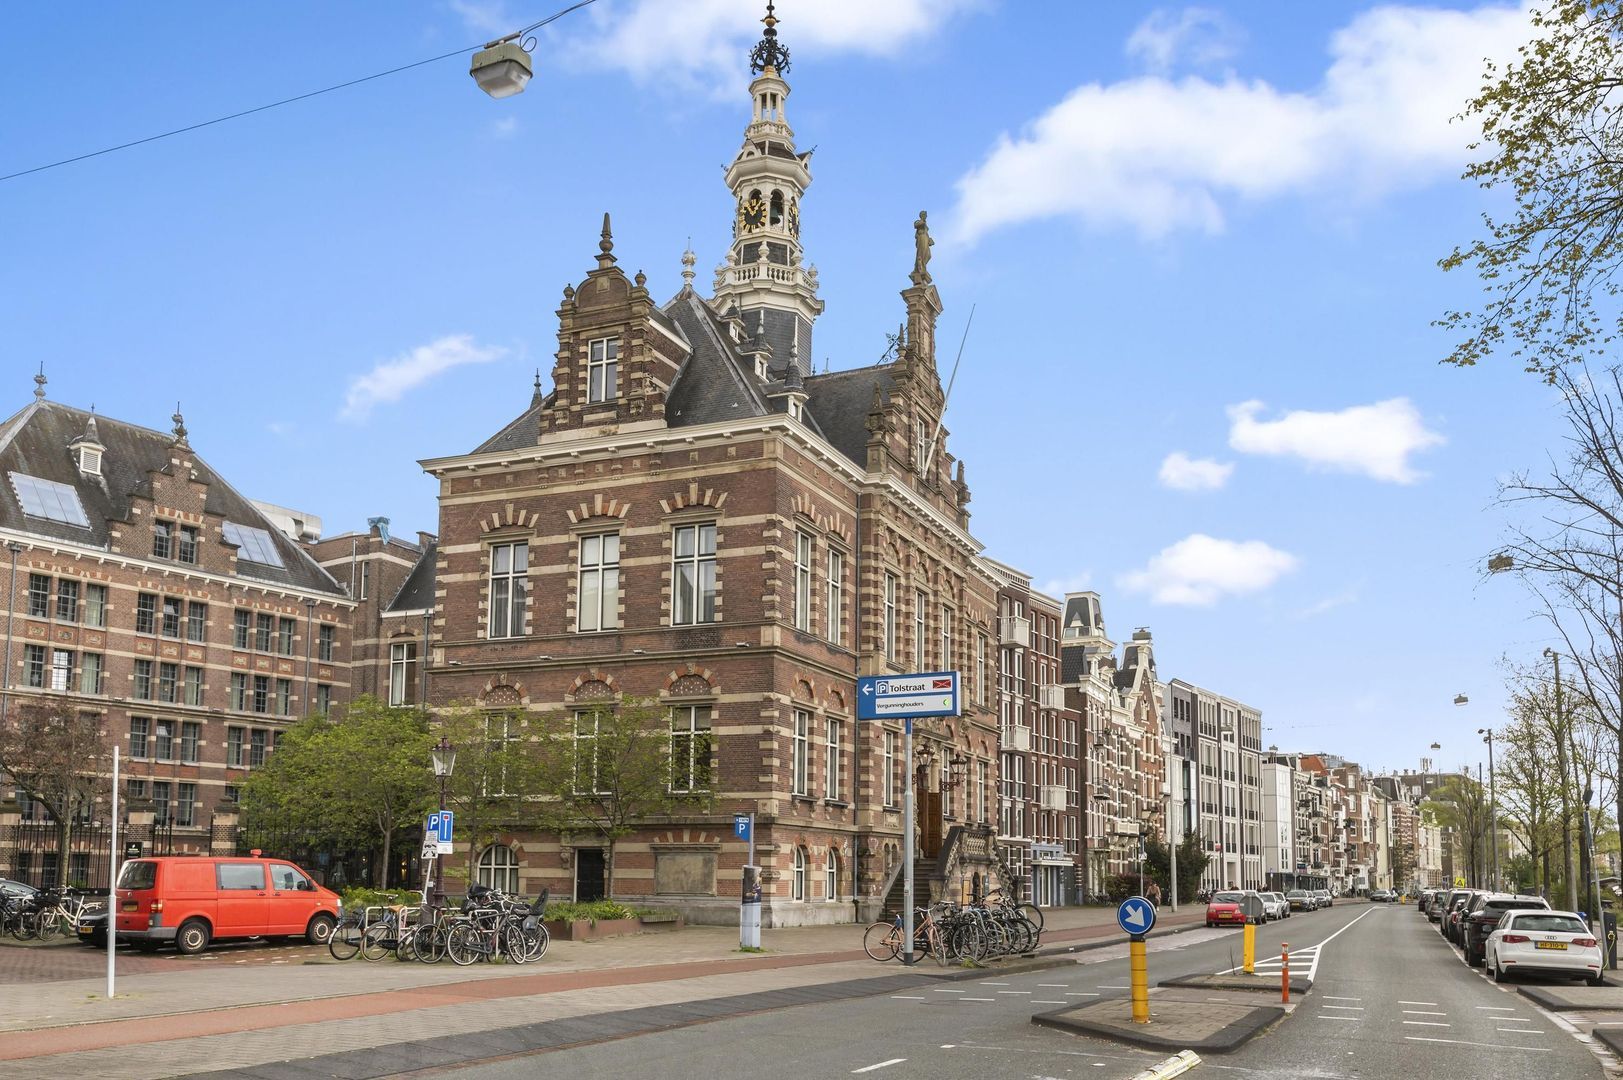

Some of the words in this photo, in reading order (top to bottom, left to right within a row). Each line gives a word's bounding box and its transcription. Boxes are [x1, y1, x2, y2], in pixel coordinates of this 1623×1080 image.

[890, 684, 926, 692] Tolstraat
[430, 816, 439, 829] P
[738, 823, 746, 834] P
